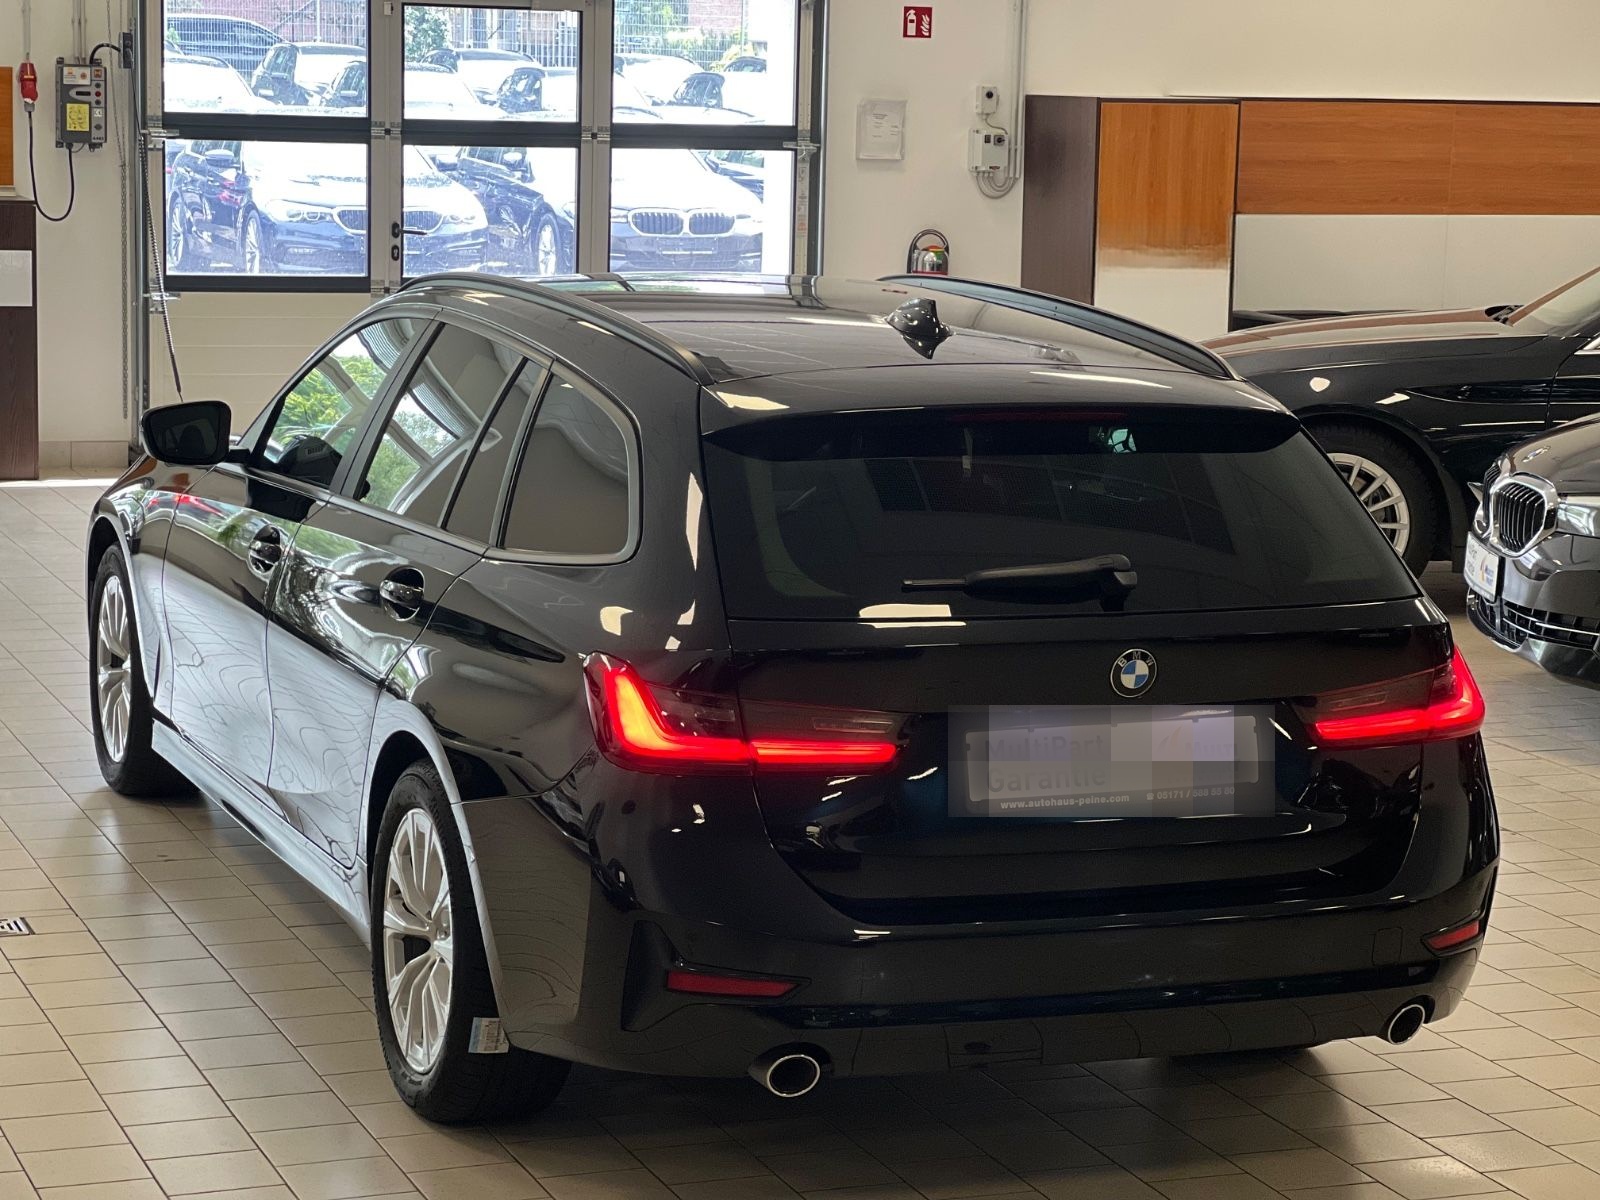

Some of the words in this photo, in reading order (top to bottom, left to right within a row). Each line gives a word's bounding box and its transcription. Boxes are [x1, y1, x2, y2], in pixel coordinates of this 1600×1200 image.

[1118, 651, 1154, 668] BMW
[985, 735, 1104, 758] MultiPart
[987, 767, 1106, 792] Garantie
[1000, 794, 1130, 809] www.autohaus-peine.com
[1157, 790, 1184, 800] 05171
